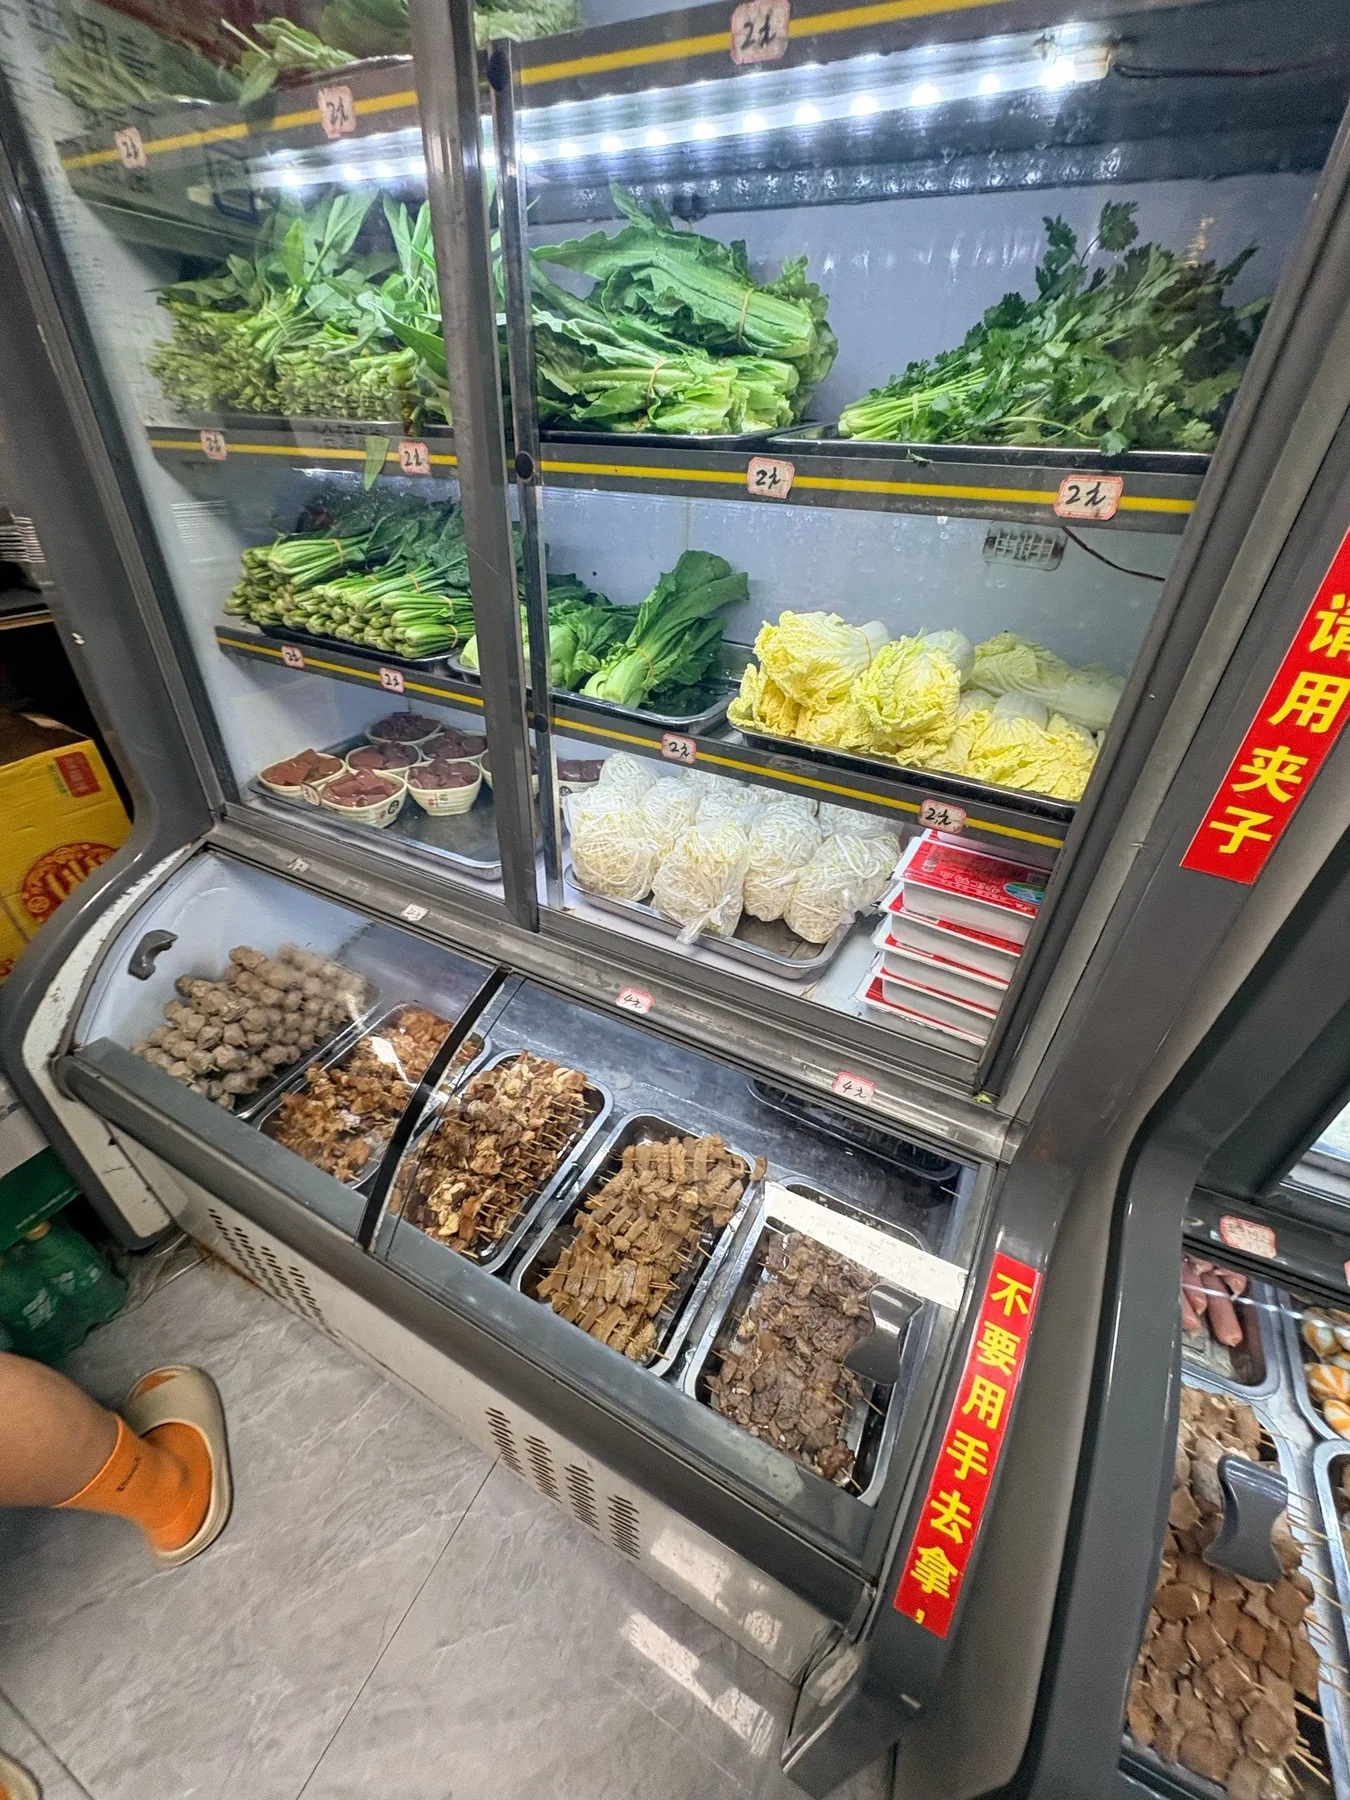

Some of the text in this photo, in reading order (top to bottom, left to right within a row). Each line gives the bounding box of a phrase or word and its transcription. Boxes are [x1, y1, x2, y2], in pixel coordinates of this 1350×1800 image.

[756, 467, 782, 490] 2元
[1065, 481, 1106, 507] 2元
[668, 741, 690, 758] 2元
[842, 1080, 866, 1099] 4元
